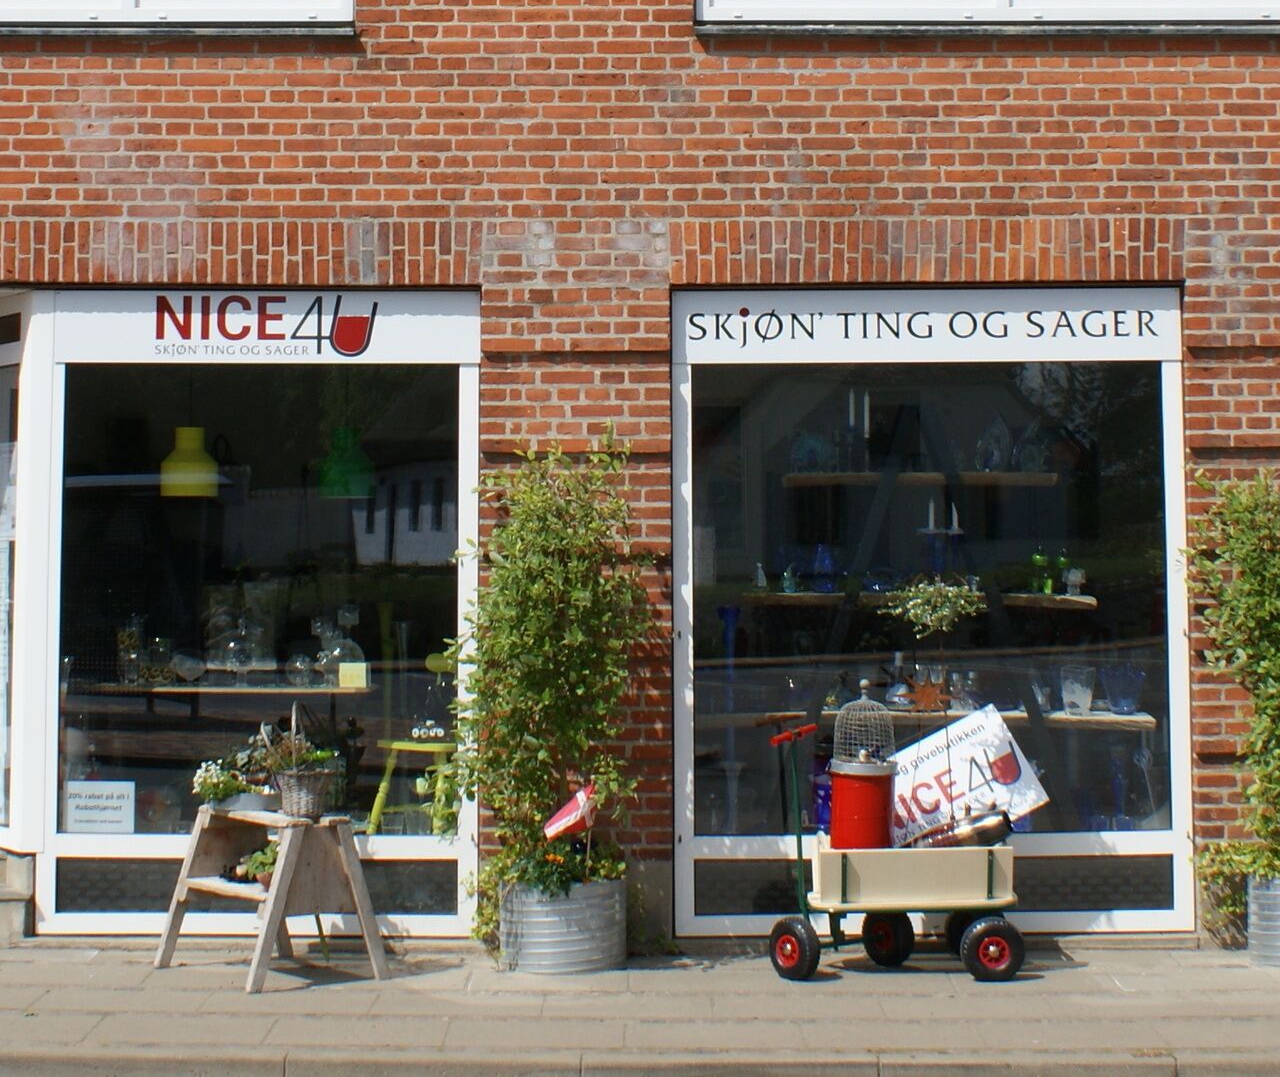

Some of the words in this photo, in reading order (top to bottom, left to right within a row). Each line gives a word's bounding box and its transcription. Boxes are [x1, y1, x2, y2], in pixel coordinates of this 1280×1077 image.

[837, 312, 934, 339] TING
[948, 311, 1009, 339] OG
[1026, 310, 1159, 338] SAGER
[204, 345, 236, 356] TING
[239, 345, 261, 356] OG
[265, 345, 310, 356] SAGER
[910, 722, 986, 769] gavebutikken
